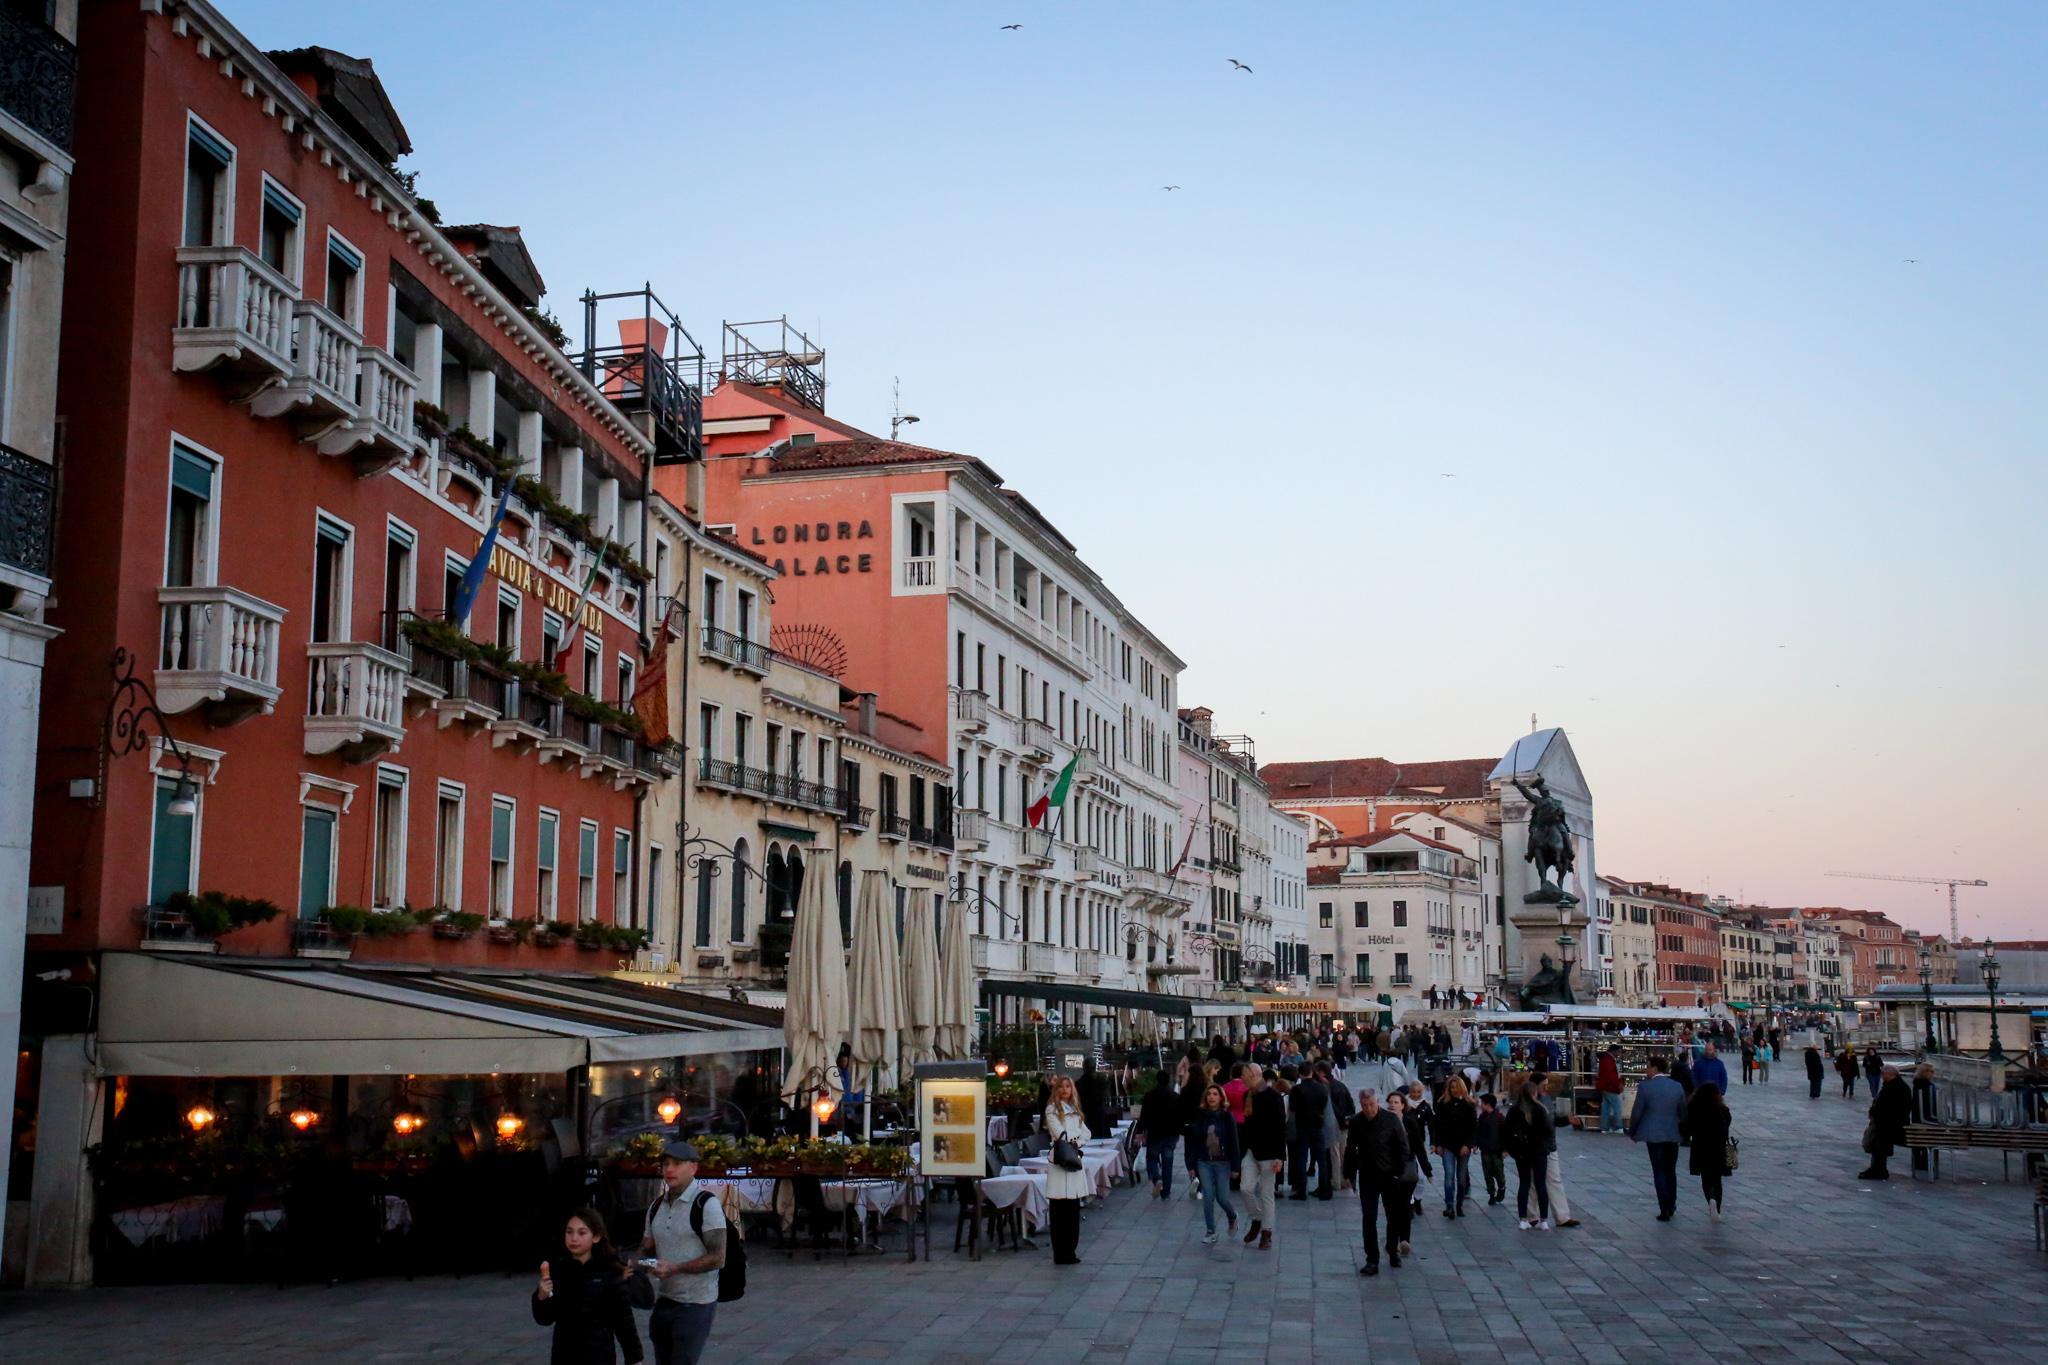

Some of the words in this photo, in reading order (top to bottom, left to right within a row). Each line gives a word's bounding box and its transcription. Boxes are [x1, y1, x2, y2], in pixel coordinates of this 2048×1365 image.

[752, 519, 873, 545] LONDRA
[478, 537, 531, 592] AVOIA
[536, 577, 544, 598] &
[772, 553, 872, 577] ALACE
[1270, 1002, 1328, 1010] RISTORANTE
